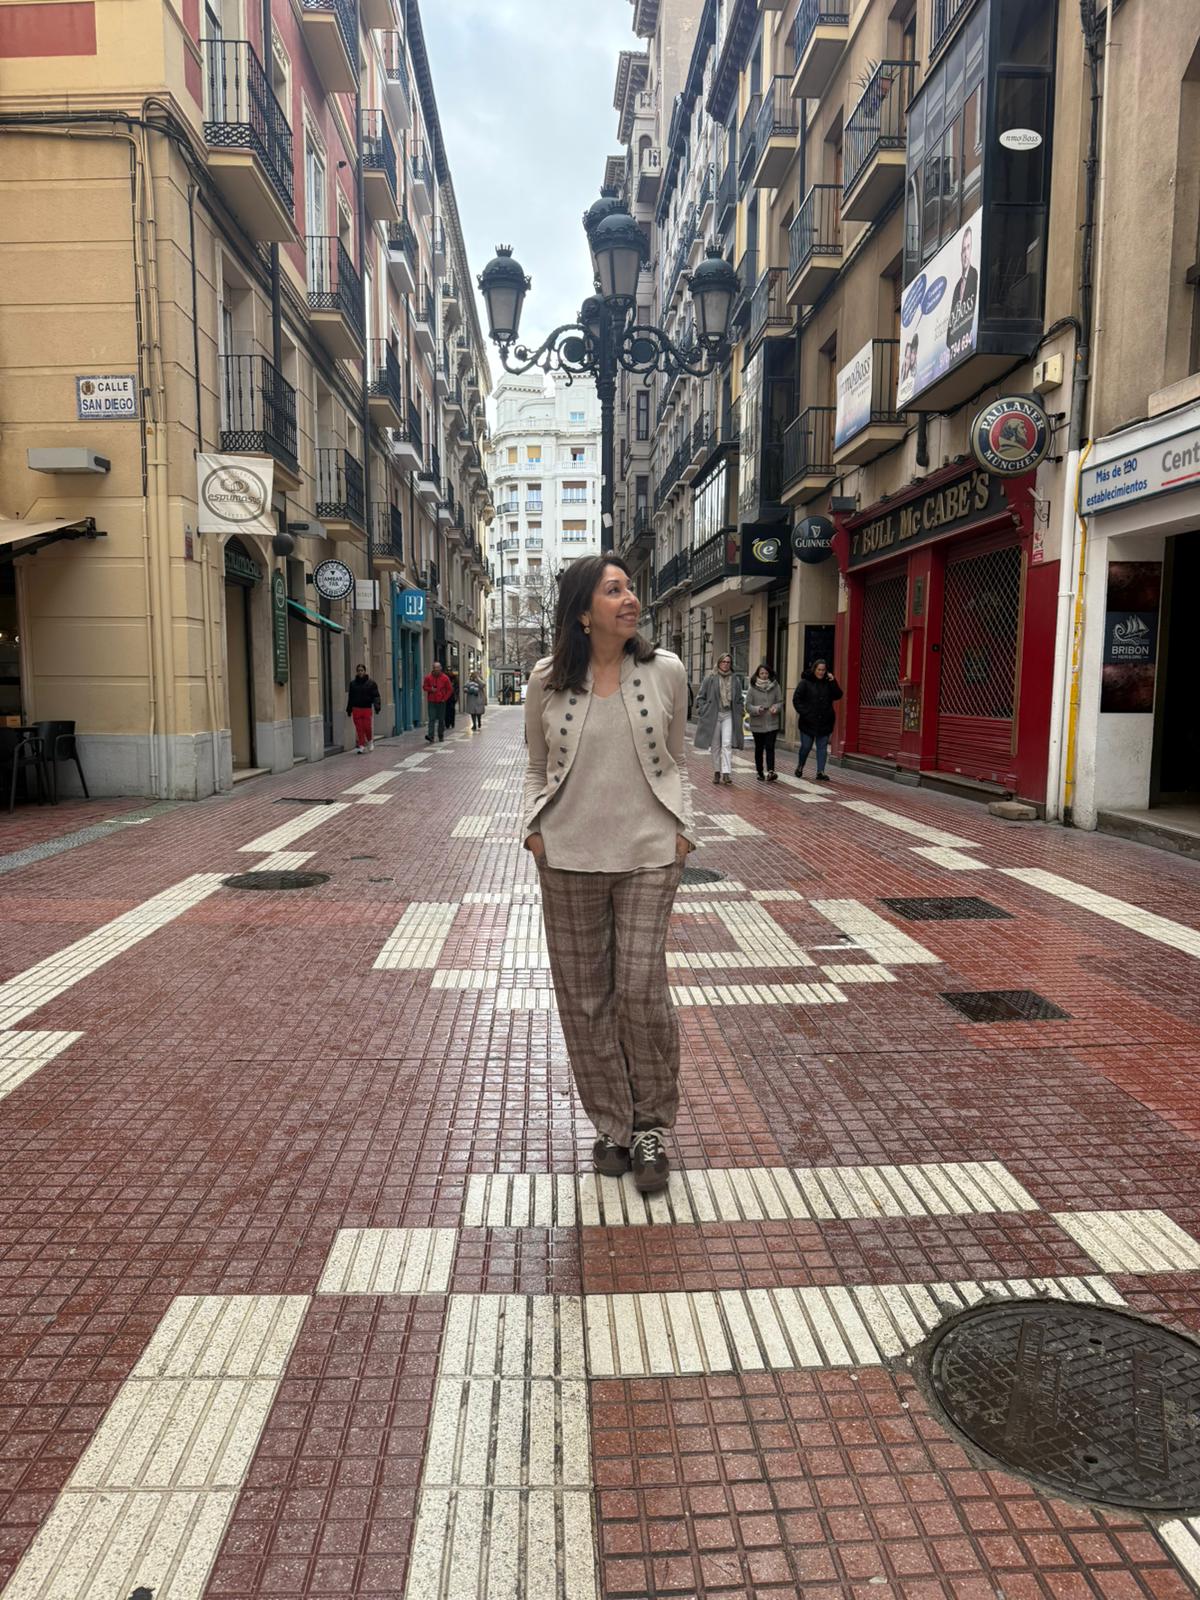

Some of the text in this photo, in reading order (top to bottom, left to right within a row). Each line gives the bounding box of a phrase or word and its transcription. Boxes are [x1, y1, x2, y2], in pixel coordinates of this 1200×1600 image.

[98, 382, 128, 391] CALLE
[82, 398, 133, 410] SAN DIEGO
[981, 402, 1044, 430] PAULANER
[1096, 469, 1110, 484] Más
[1111, 464, 1121, 478] de
[1086, 480, 1148, 506] establecimientos
[861, 516, 896, 555] BULL
[1112, 646, 1149, 655] BRIBON
